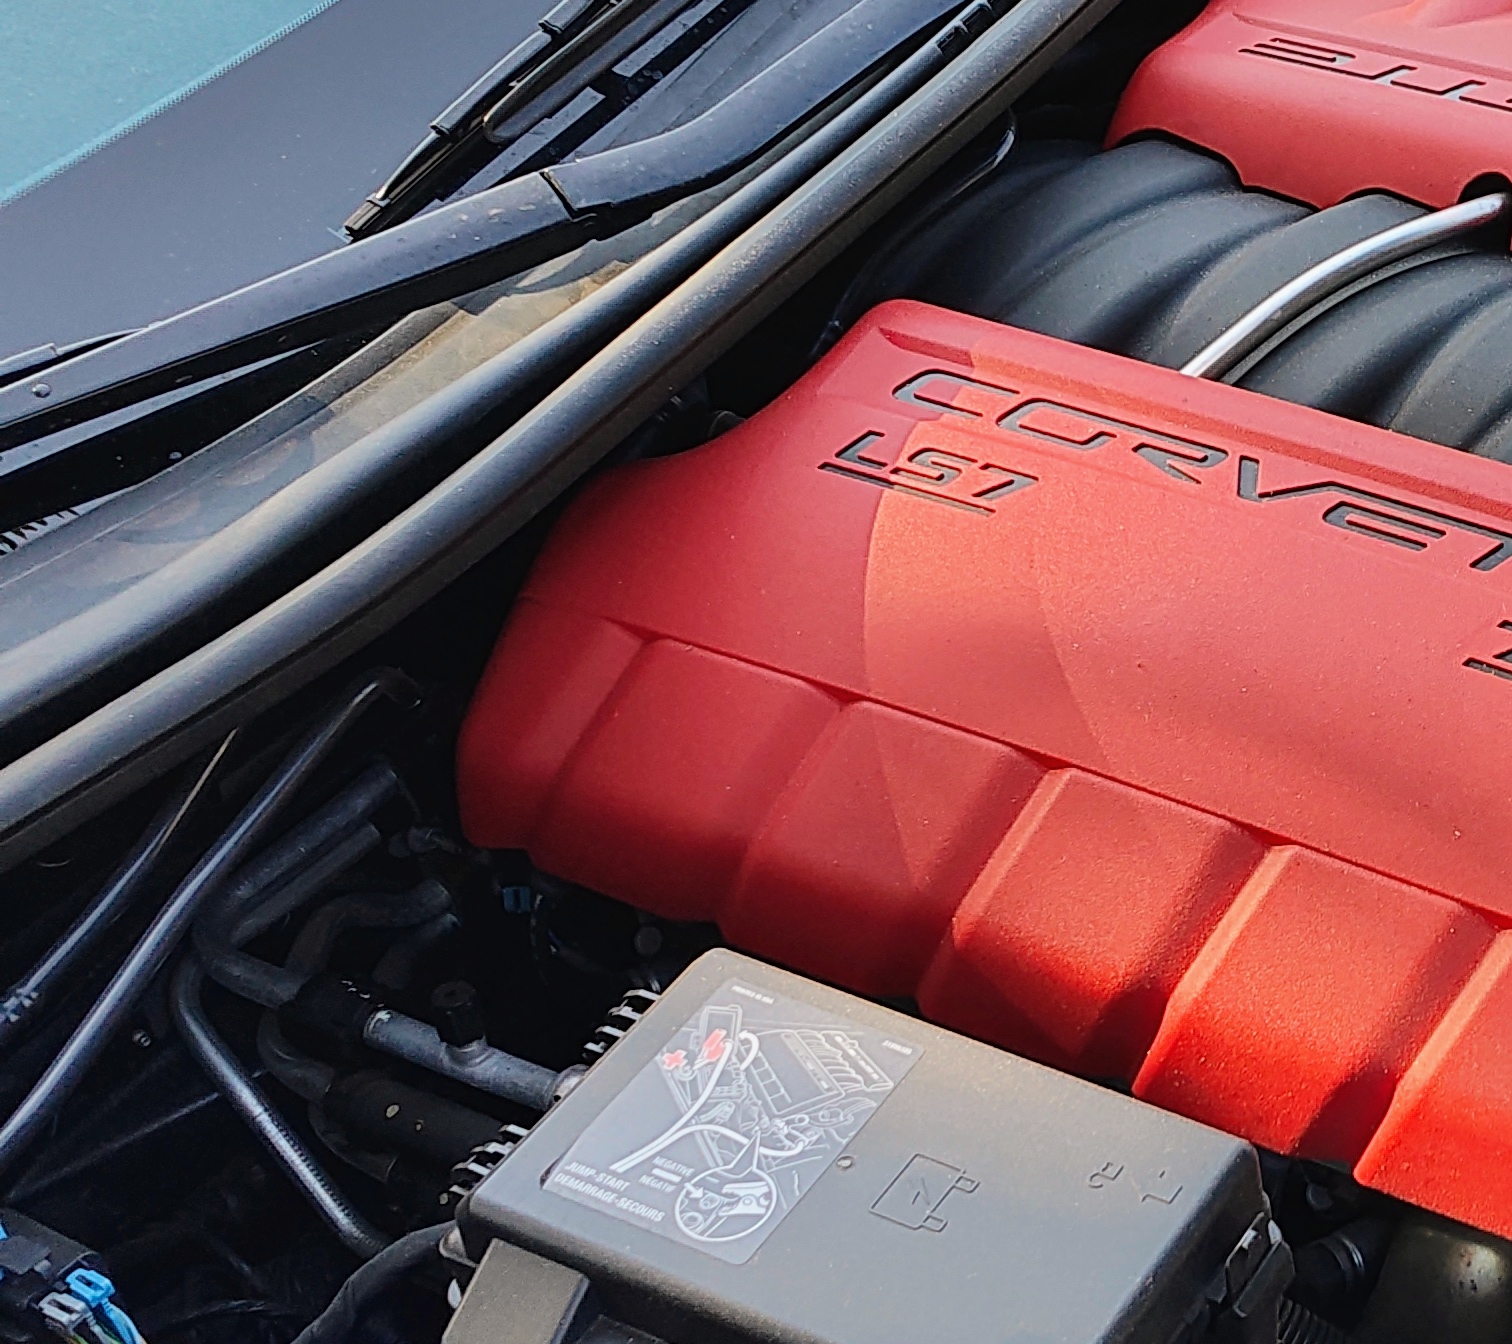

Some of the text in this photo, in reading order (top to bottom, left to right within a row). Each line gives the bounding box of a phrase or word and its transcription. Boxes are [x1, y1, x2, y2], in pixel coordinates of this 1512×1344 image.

[834, 429, 1040, 502] LS7
[564, 1161, 632, 1192] JUMP-START
[652, 1155, 696, 1177] NEGATIVE
